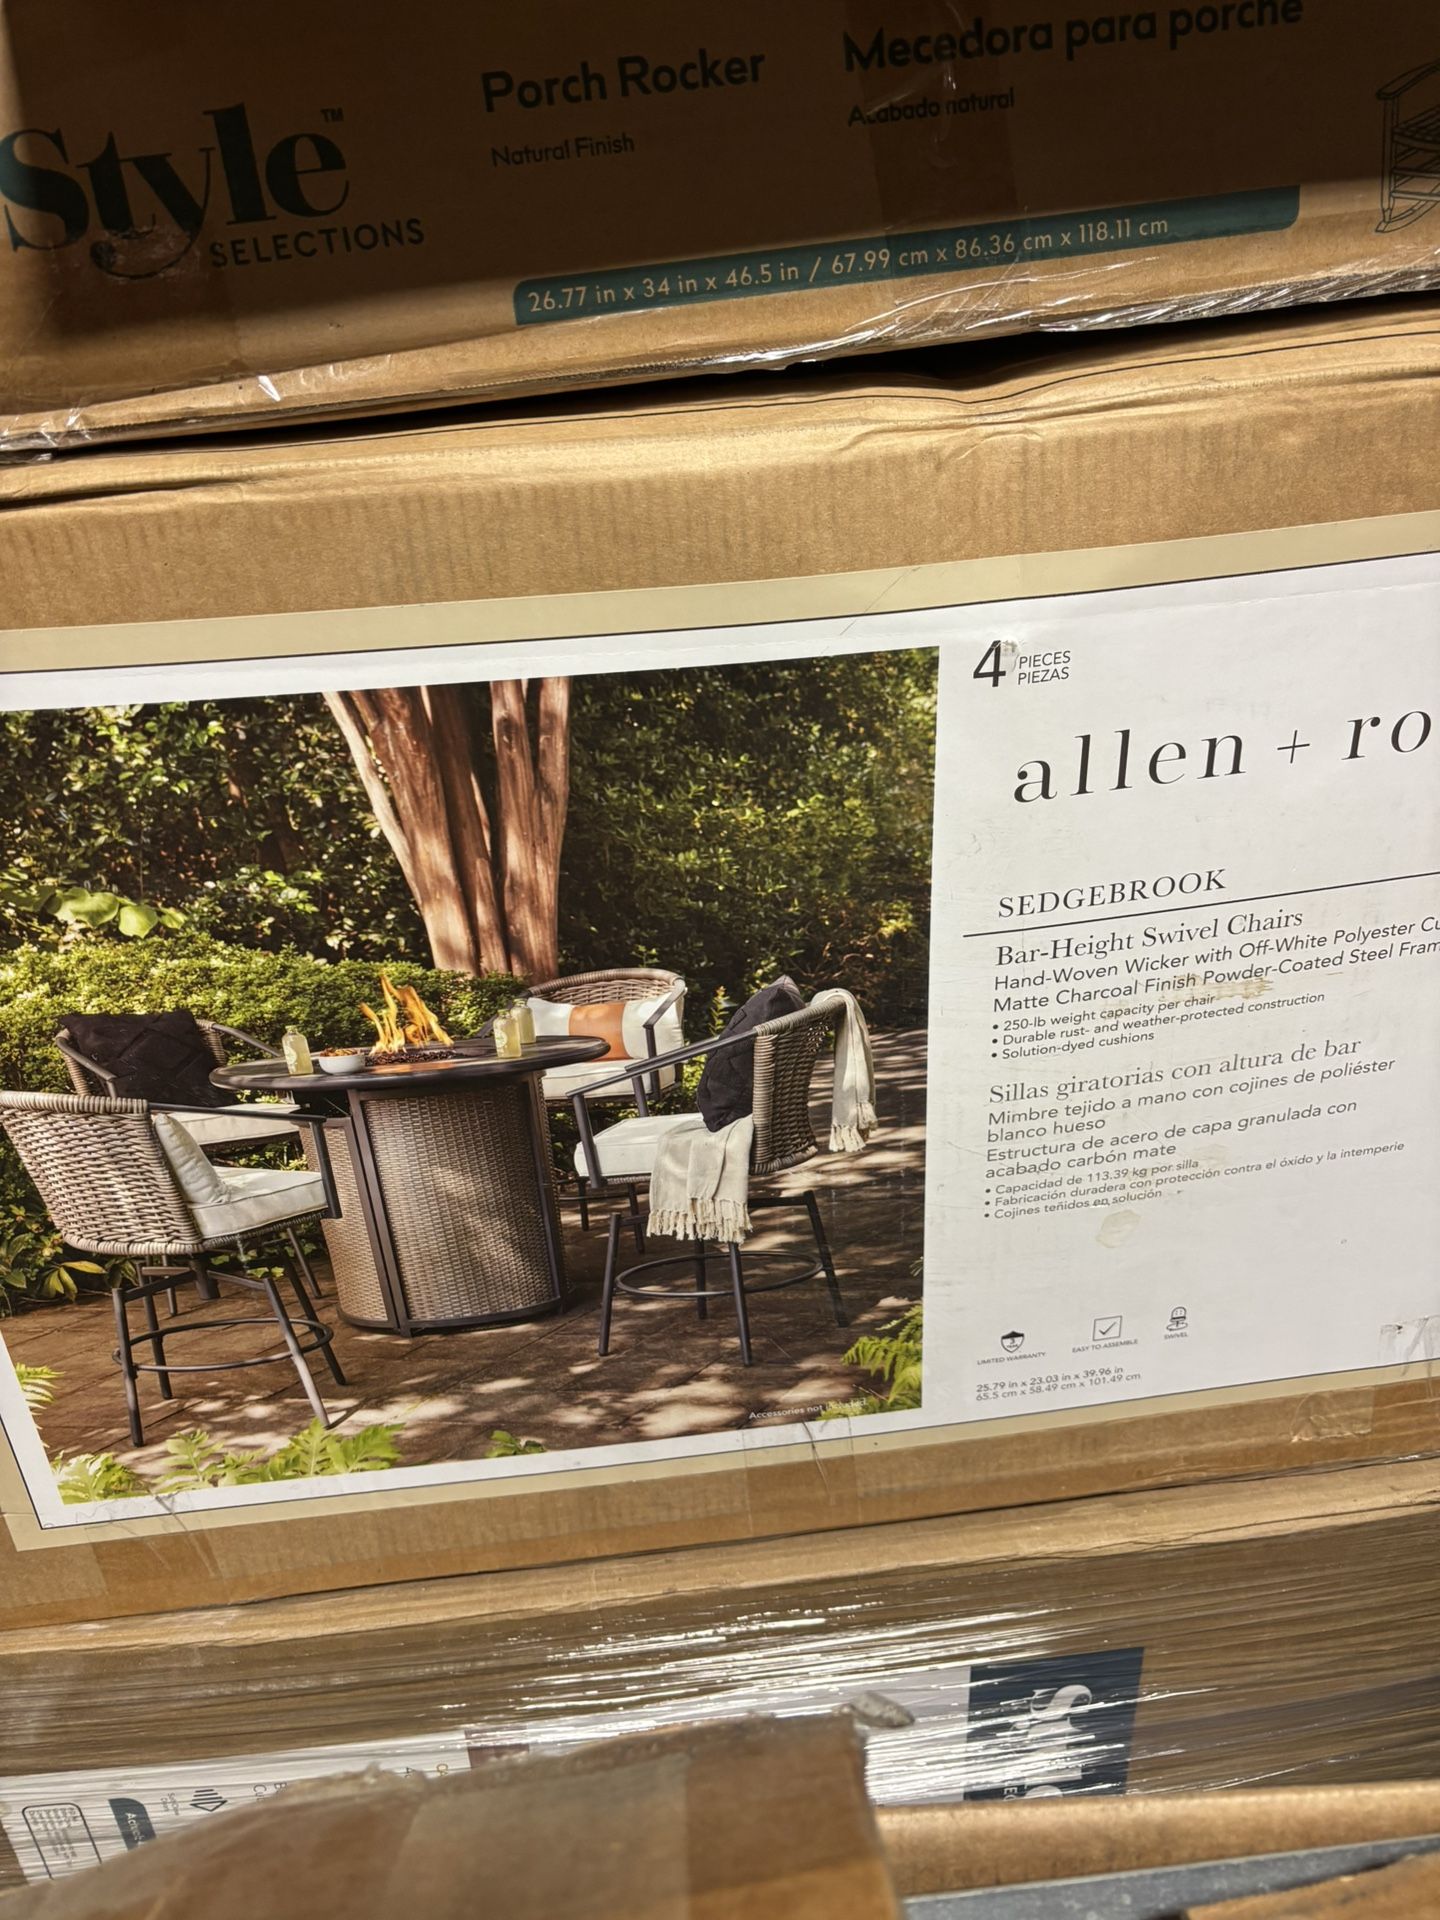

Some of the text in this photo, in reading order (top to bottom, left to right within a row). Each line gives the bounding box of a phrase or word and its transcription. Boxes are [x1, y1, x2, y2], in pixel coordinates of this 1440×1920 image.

[843, 0, 1304, 72] Mecedora para porche
[482, 48, 765, 112] Porch Rocker
[947, 88, 1015, 115] natural
[492, 133, 635, 167] Natural Finish
[0, 102, 350, 280] Style
[209, 218, 425, 268] SELECTIONS
[528, 286, 587, 312] 26.77
[596, 286, 616, 304] in
[624, 287, 635, 300] x
[643, 277, 670, 298] 34
[678, 275, 698, 294] in
[705, 277, 718, 290] x
[725, 264, 772, 287] 46.5
[780, 262, 799, 281] in
[831, 248, 890, 275] 67.99
[899, 250, 928, 267] cm
[936, 247, 947, 262] x
[955, 233, 1015, 259] 86.36
[1023, 234, 1052, 250] cm
[1060, 231, 1071, 246] x
[1079, 219, 1131, 243] 118.11
[1139, 219, 1168, 236] cm
[973, 639, 1007, 687] 4
[1017, 666, 1070, 686] PIEZAS
[1018, 650, 1071, 670] PIECES
[1013, 729, 1247, 803] allen
[999, 869, 1226, 918] SEDGEBROOK
[995, 966, 1118, 990] Hand-Woven
[1125, 954, 1189, 974] Wicker
[1195, 946, 1232, 964] with
[1239, 935, 1327, 958] Off-White
[1334, 923, 1415, 945] Polyester
[996, 909, 1303, 966] Bar-Height Swivel Chairs
[994, 996, 1049, 1012] Matte
[1056, 981, 1138, 1004] Charcoal
[1145, 973, 1198, 993] Finish
[1203, 950, 1344, 985] Powder-Coated
[1349, 943, 1393, 964] Steel
[1003, 993, 1324, 1049] Durable rust- and weather-protected construction
[1004, 994, 1215, 1032] 250-lb weight capacity per chair
[1002, 1033, 1154, 1059] Solution-dyed cushions
[990, 1040, 1361, 1103] Sillas giratorias con altura de bar
[988, 1060, 1395, 1127] Mimbre tejido a mano con cojines de poliéster
[987, 1102, 1357, 1164] Estructura de acero de capa granulada con
[988, 1119, 1105, 1142] blanco hueso
[986, 1145, 1176, 1178] acabado carbón mate
[995, 1142, 1404, 1208] Fabricación duradera con protección contra el óxido y la intemperie
[996, 1159, 1199, 1196] Capacidad de 113.39 kg por silla
[994, 1189, 1162, 1219] Cojines teñidos en solución
[1102, 1338, 1139, 1348] ASSEMBLE
[1163, 1332, 1188, 1340] SWIVEL
[976, 1352, 1046, 1365] LIMITED WARRANTY
[976, 1382, 1006, 1392] 25.79
[1030, 1375, 1059, 1385] 23.03
[1062, 1373, 1071, 1381] in
[1083, 1368, 1111, 1379] 39.96
[1113, 1366, 1123, 1374] in
[976, 1391, 999, 1401] 65.5
[1002, 1390, 1017, 1398] cm
[1030, 1384, 1058, 1394] 58.49
[1090, 1375, 1123, 1385] 101.49
[749, 1407, 805, 1419] Accessories
[807, 1404, 823, 1413] not
